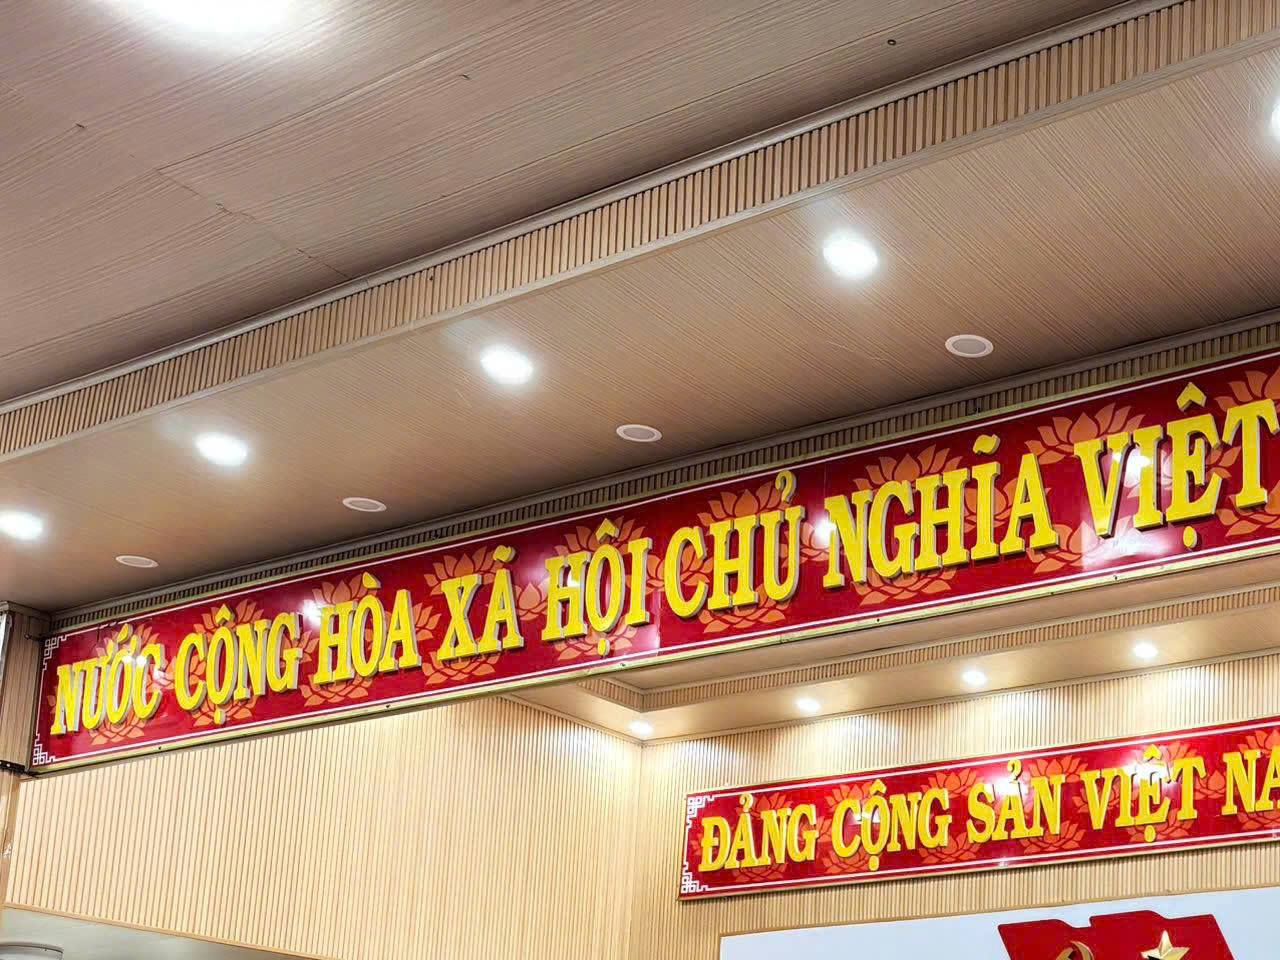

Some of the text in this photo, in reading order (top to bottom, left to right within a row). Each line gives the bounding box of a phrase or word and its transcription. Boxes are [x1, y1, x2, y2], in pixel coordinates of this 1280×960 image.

[50, 622, 166, 736] NƯỚC
[174, 603, 303, 726] CỘNG
[313, 571, 422, 686] HÒA
[437, 544, 525, 662] XÃ
[541, 517, 653, 658] HỘI
[664, 470, 805, 619] CHỦ
[822, 433, 1059, 590] NGHĨA
[1074, 381, 1280, 551] VIỆT
[698, 792, 820, 872] ĐẢNG
[831, 778, 953, 872] CỘNG
[966, 757, 1066, 844] SẢN
[1079, 743, 1208, 843] VIỆT
